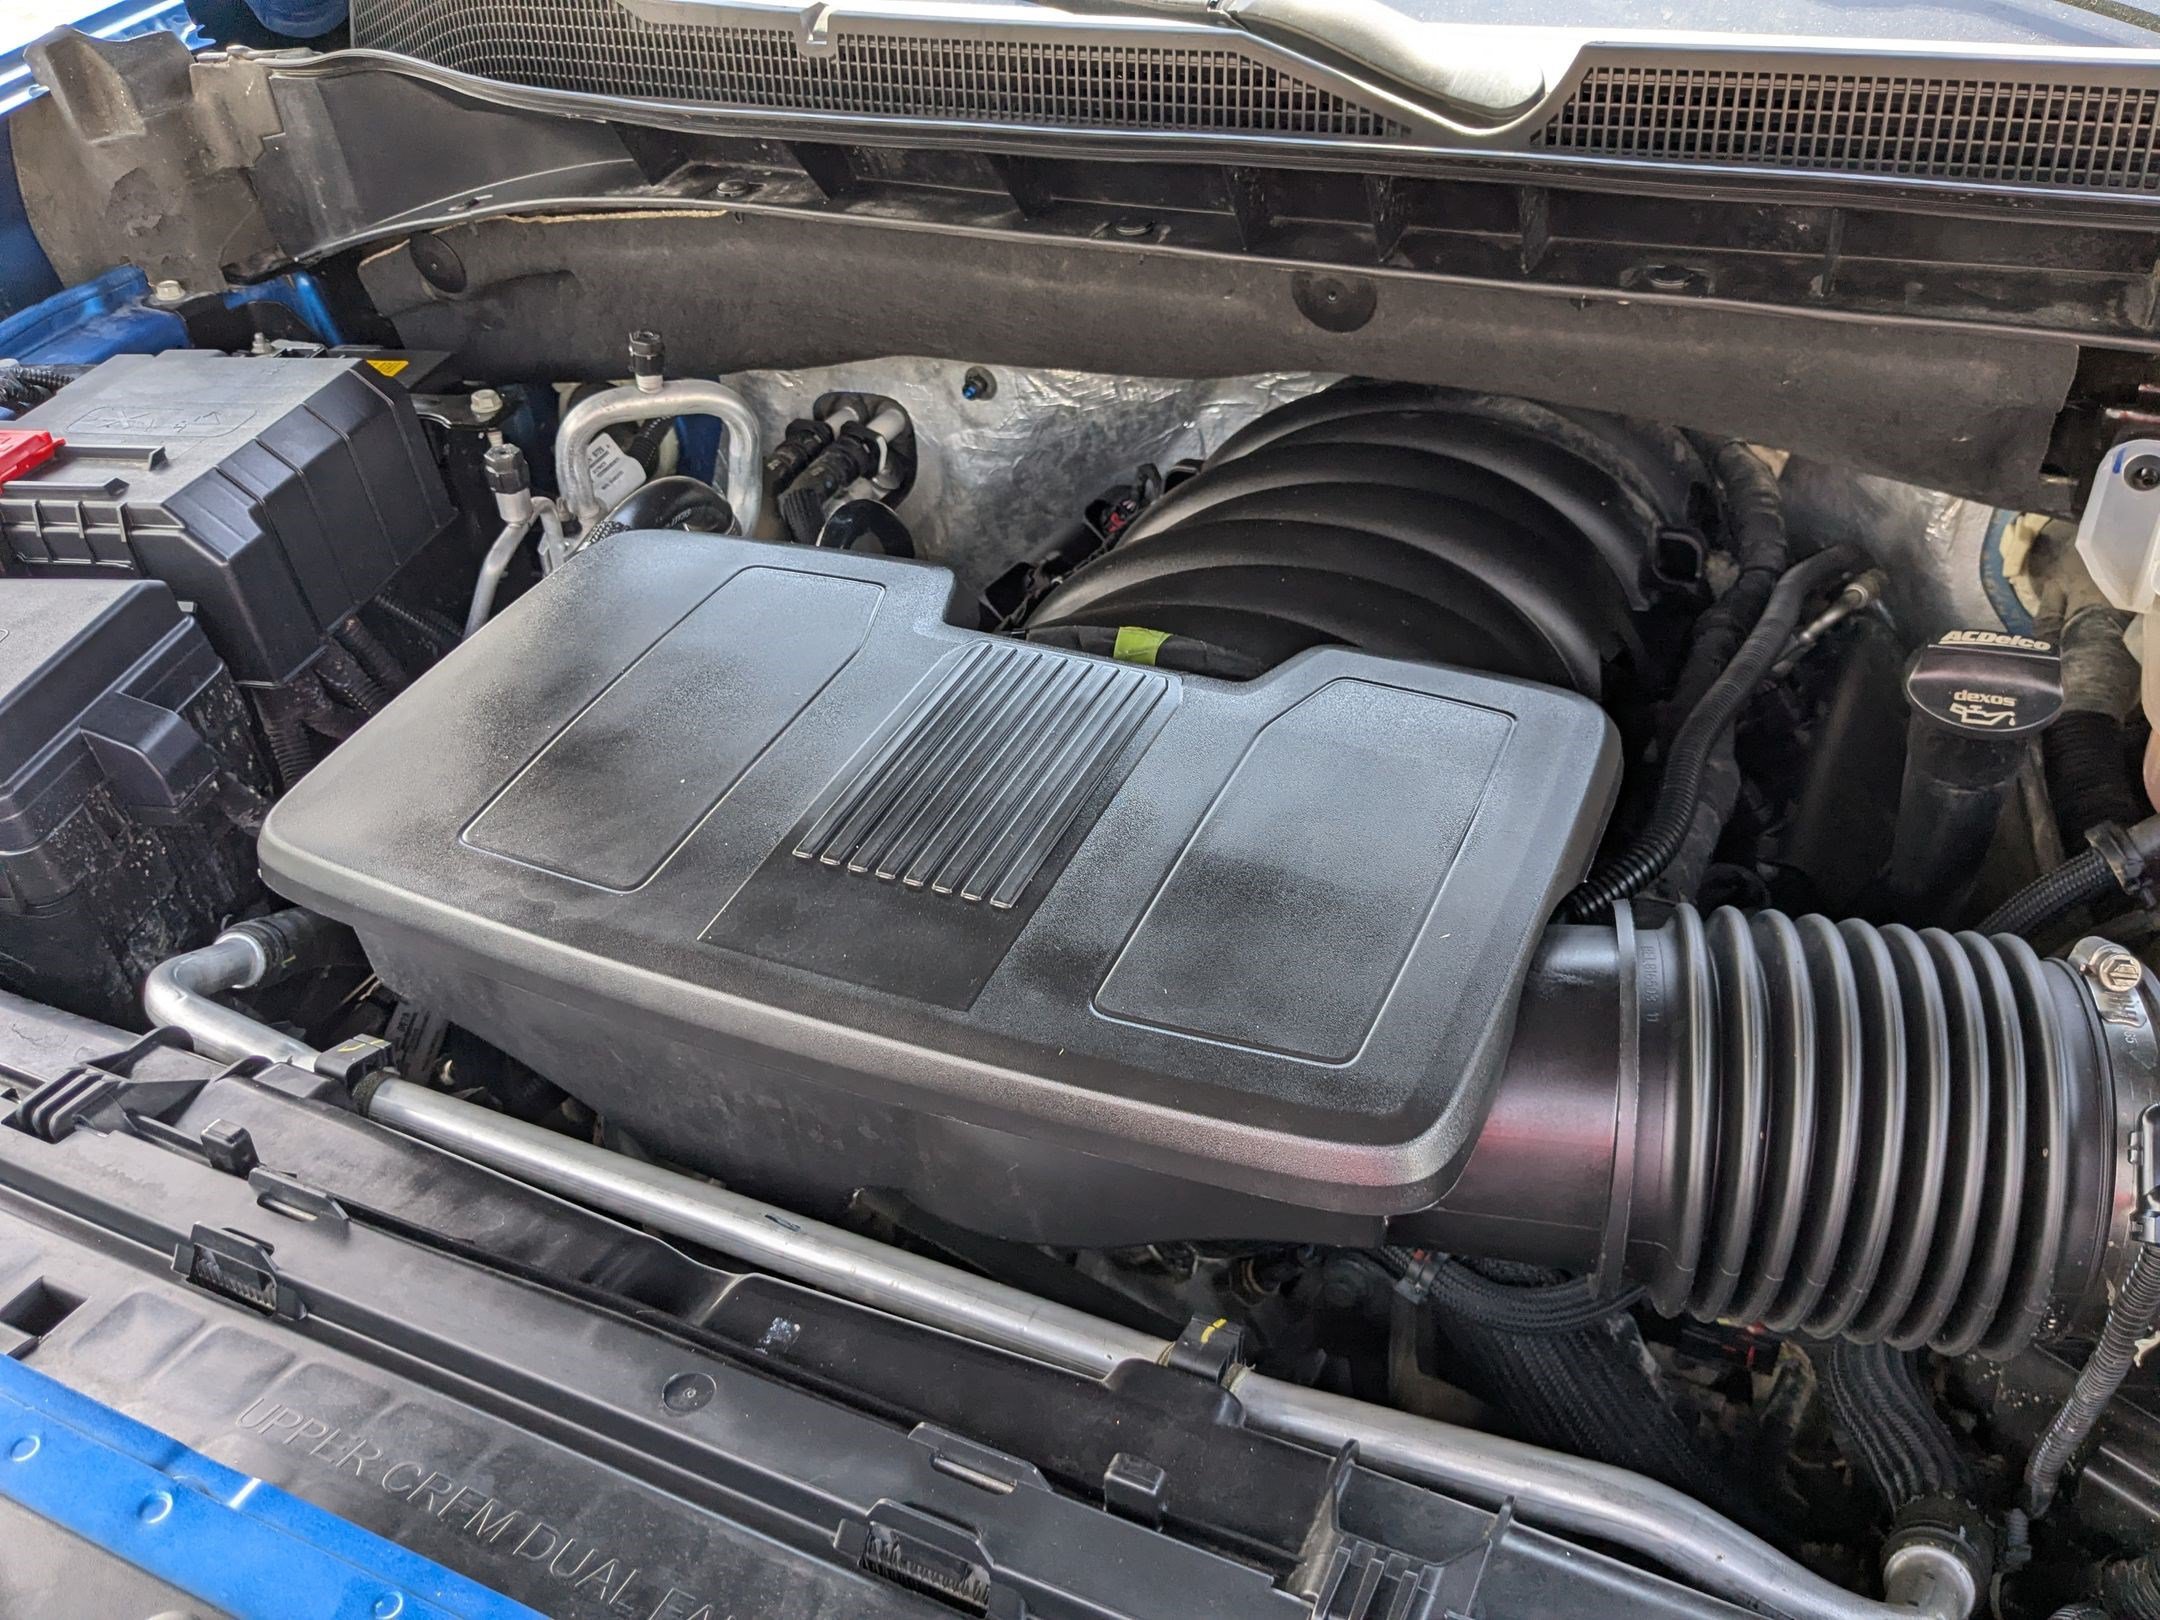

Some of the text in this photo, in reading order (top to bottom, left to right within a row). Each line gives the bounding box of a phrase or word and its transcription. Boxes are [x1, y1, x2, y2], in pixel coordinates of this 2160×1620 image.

[1939, 630, 2051, 651] ACDelco
[1954, 690, 2017, 707] dexos
[236, 1398, 383, 1476] UPPER
[512, 1522, 638, 1611] DUAL
